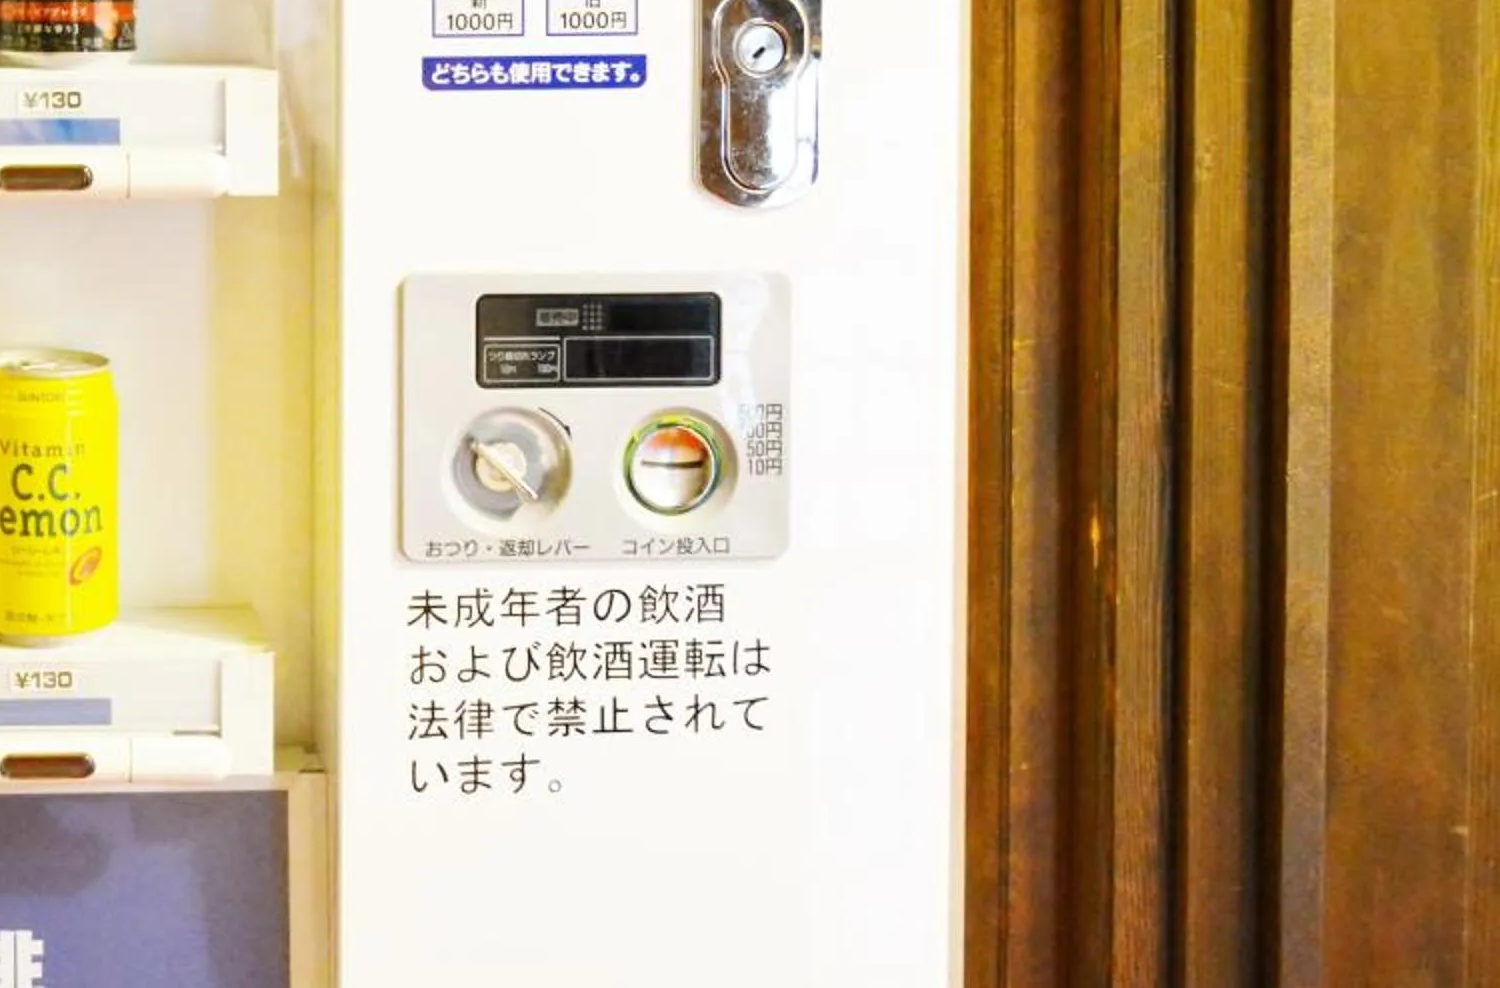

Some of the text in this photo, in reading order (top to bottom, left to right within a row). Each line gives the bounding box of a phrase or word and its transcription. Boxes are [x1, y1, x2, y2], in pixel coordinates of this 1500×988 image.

[446, 13, 514, 32] 1000円
[559, 11, 627, 30] 1000円
[431, 63, 640, 86] どちらも使用できます。
[23, 90, 82, 110] ¥130
[744, 421, 783, 439] 00円
[0, 438, 86, 458] Vitamin
[747, 458, 783, 477] 10円
[12, 463, 81, 503] C.C.
[621, 536, 731, 556] コイン投入口
[407, 583, 726, 629] 未成年者の飲酒
[409, 638, 772, 685] および飲酒運転は
[15, 670, 73, 690] ¥130
[407, 693, 770, 741] 法律で禁止されて
[410, 752, 562, 795] います。
